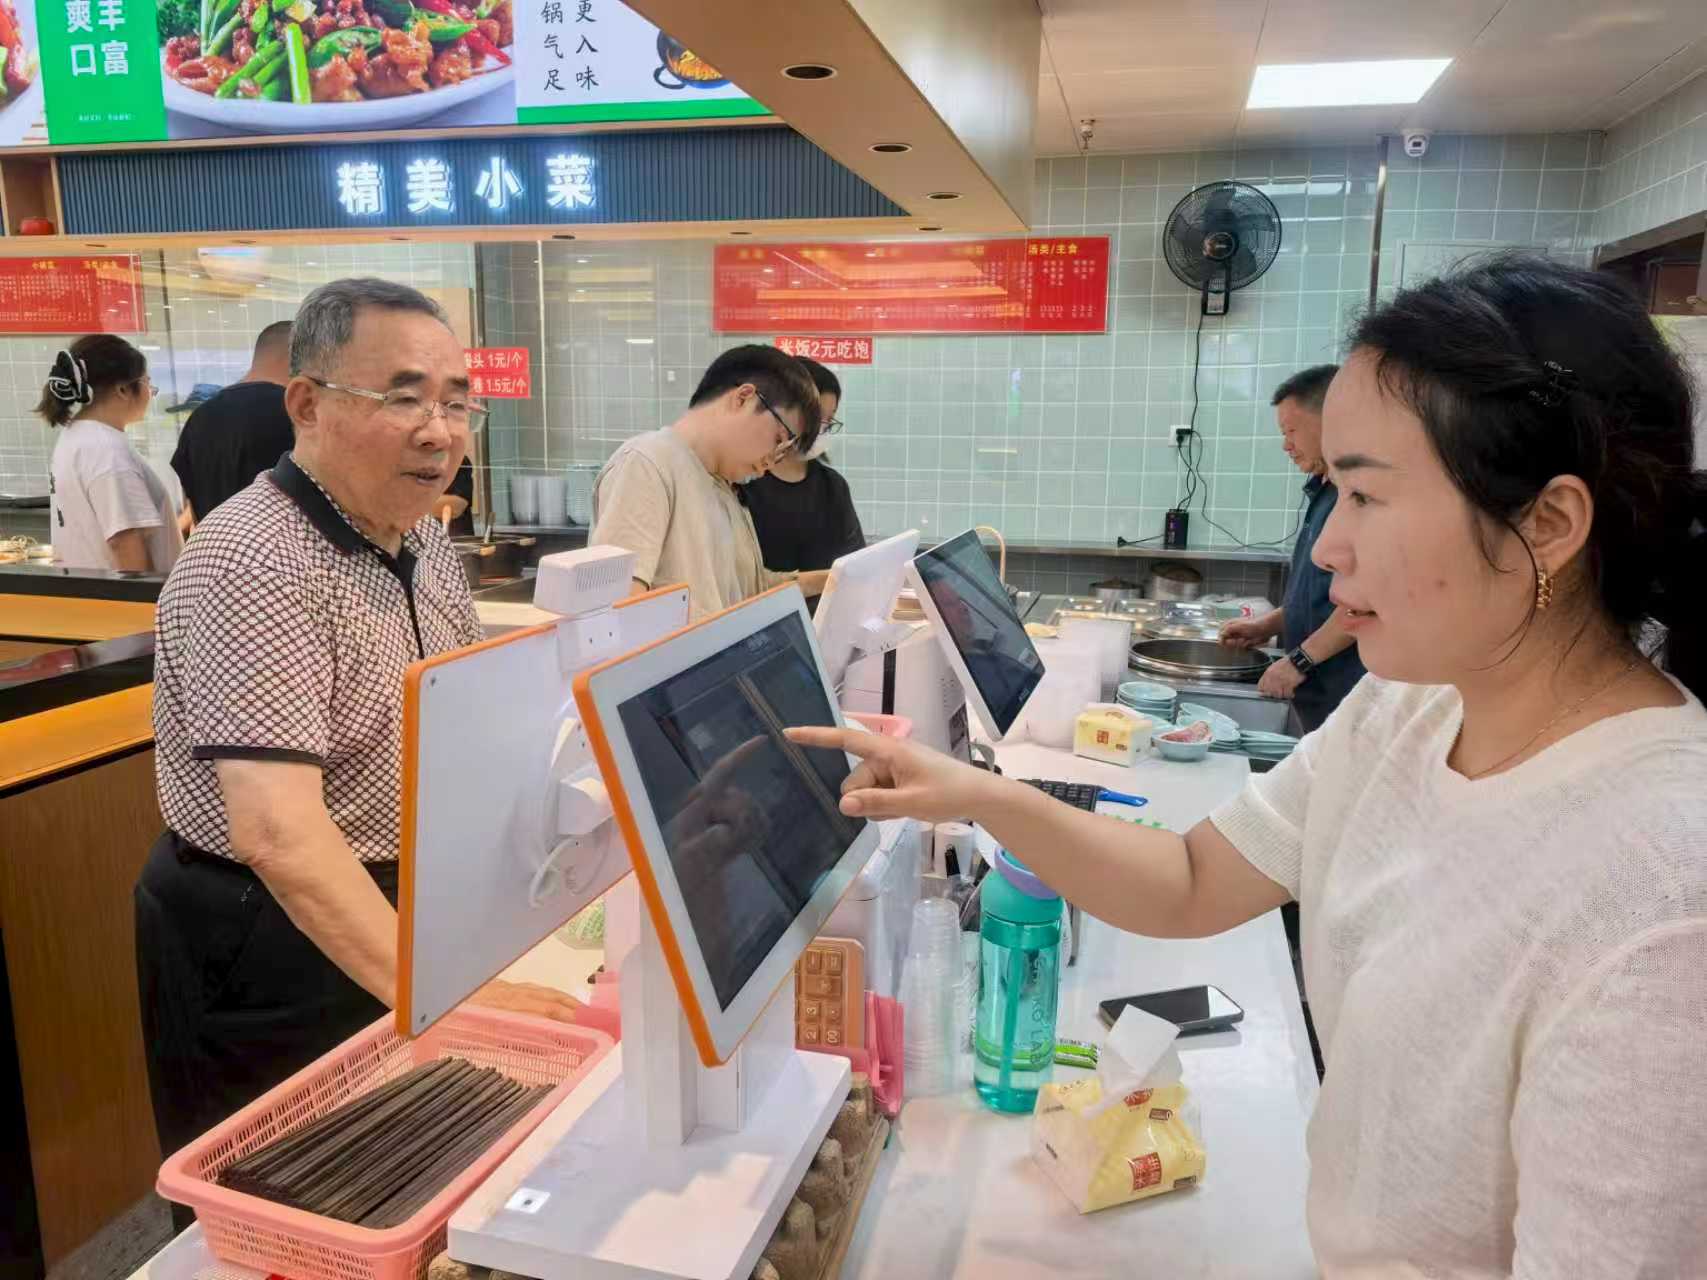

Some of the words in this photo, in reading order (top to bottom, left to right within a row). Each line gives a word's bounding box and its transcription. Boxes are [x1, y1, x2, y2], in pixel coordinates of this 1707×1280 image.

[540, 1, 566, 91] 锅气足
[336, 152, 598, 216] 精美小菜
